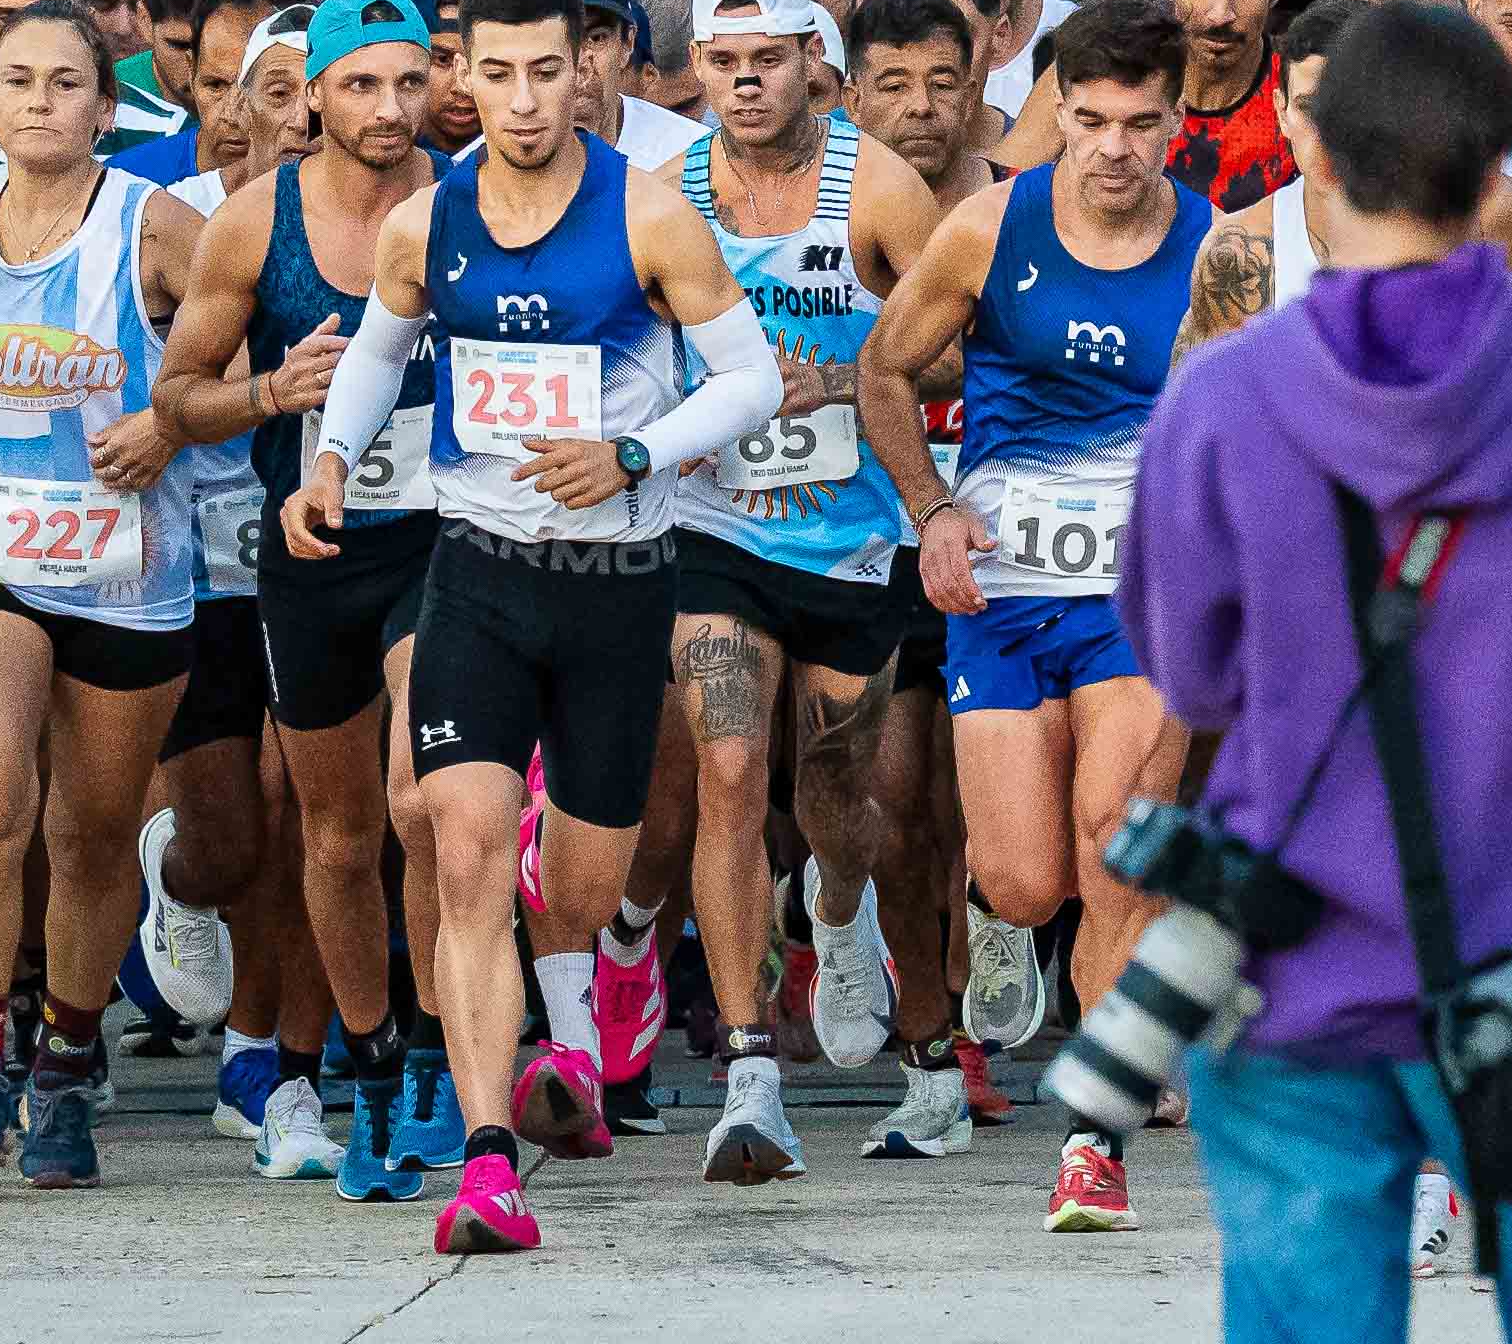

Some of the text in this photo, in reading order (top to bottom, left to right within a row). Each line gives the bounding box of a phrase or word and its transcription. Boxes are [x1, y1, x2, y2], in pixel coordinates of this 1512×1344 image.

[502, 312, 544, 322] running
[772, 284, 853, 319] POSIBLE
[1071, 341, 1119, 354] running
[466, 368, 580, 428] 231
[6, 507, 121, 560] 227
